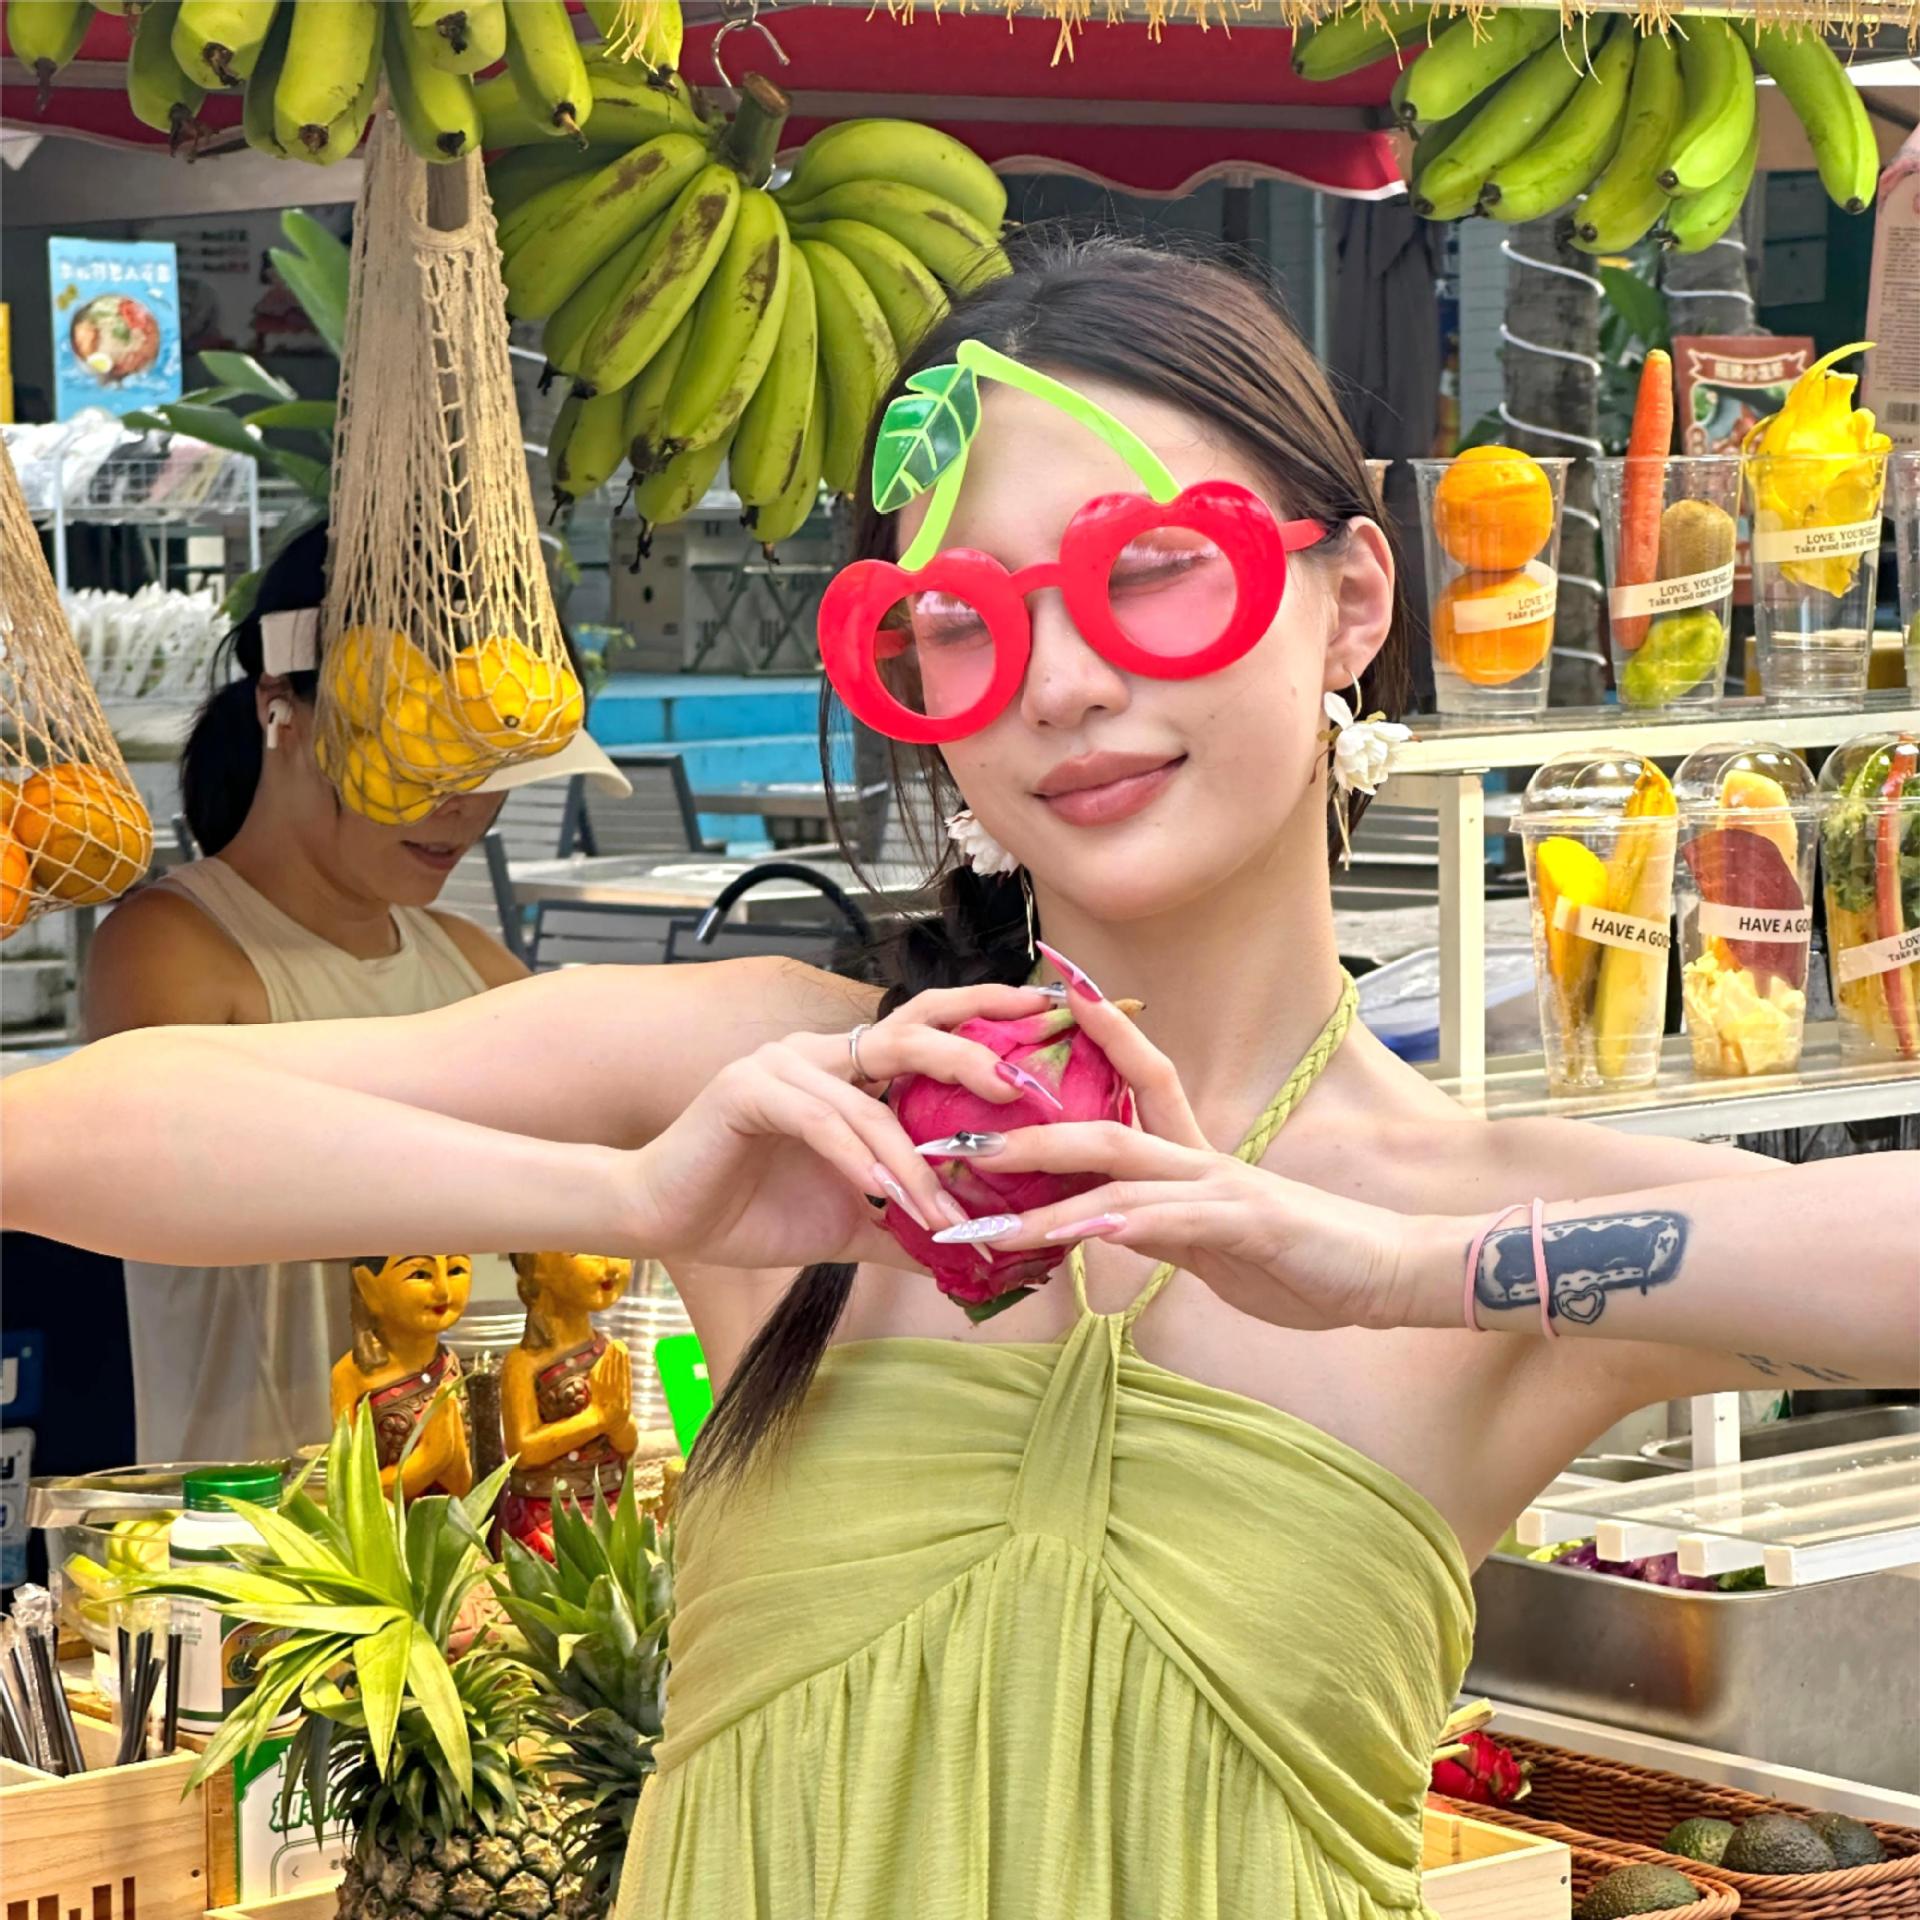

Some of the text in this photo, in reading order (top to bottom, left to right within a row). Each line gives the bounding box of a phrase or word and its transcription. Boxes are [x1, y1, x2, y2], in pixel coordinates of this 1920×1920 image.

[1806, 531, 1836, 545] LOVE
[1794, 545, 1816, 554] Take
[1819, 542, 1840, 553] good
[1660, 582, 1689, 597] LOVE
[1518, 595, 1542, 610] LOVE
[1648, 597, 1671, 608] Take
[1673, 592, 1695, 605] good
[1591, 917, 1635, 940] HAVE
[1636, 928, 1647, 943] A
[1738, 917, 1781, 933] HAVE
[1783, 919, 1793, 933] A
[1888, 949, 1912, 962] Take
